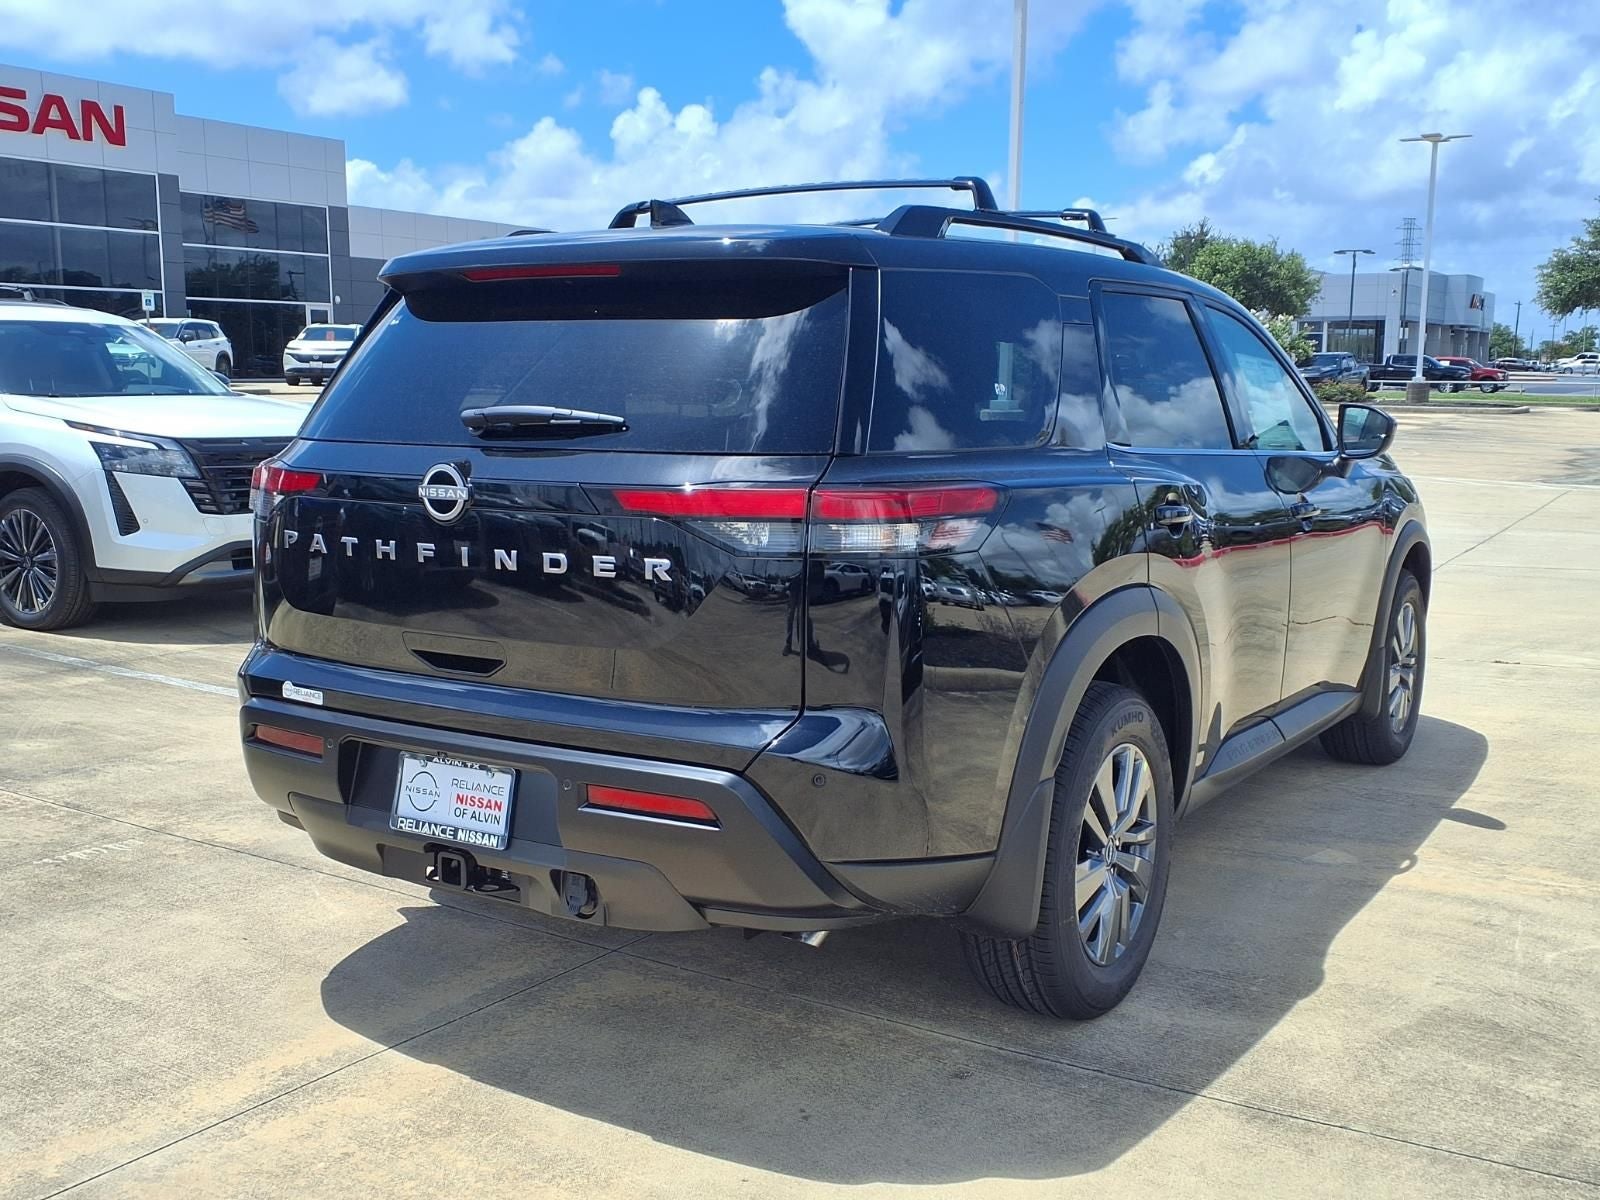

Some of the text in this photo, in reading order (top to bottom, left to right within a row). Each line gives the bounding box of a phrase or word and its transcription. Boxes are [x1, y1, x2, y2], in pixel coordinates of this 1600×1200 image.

[418, 486, 467, 499] NISSAN
[284, 529, 672, 582] PATHFINDER
[1110, 711, 1144, 738] KUMHO
[465, 762, 481, 770] TX
[405, 784, 441, 798] NISSAN
[451, 778, 505, 796] RELIANCE
[455, 793, 503, 812] NISSAN
[454, 807, 501, 826] OF ALVIN
[397, 817, 498, 848] RELIANCE NISSAN
